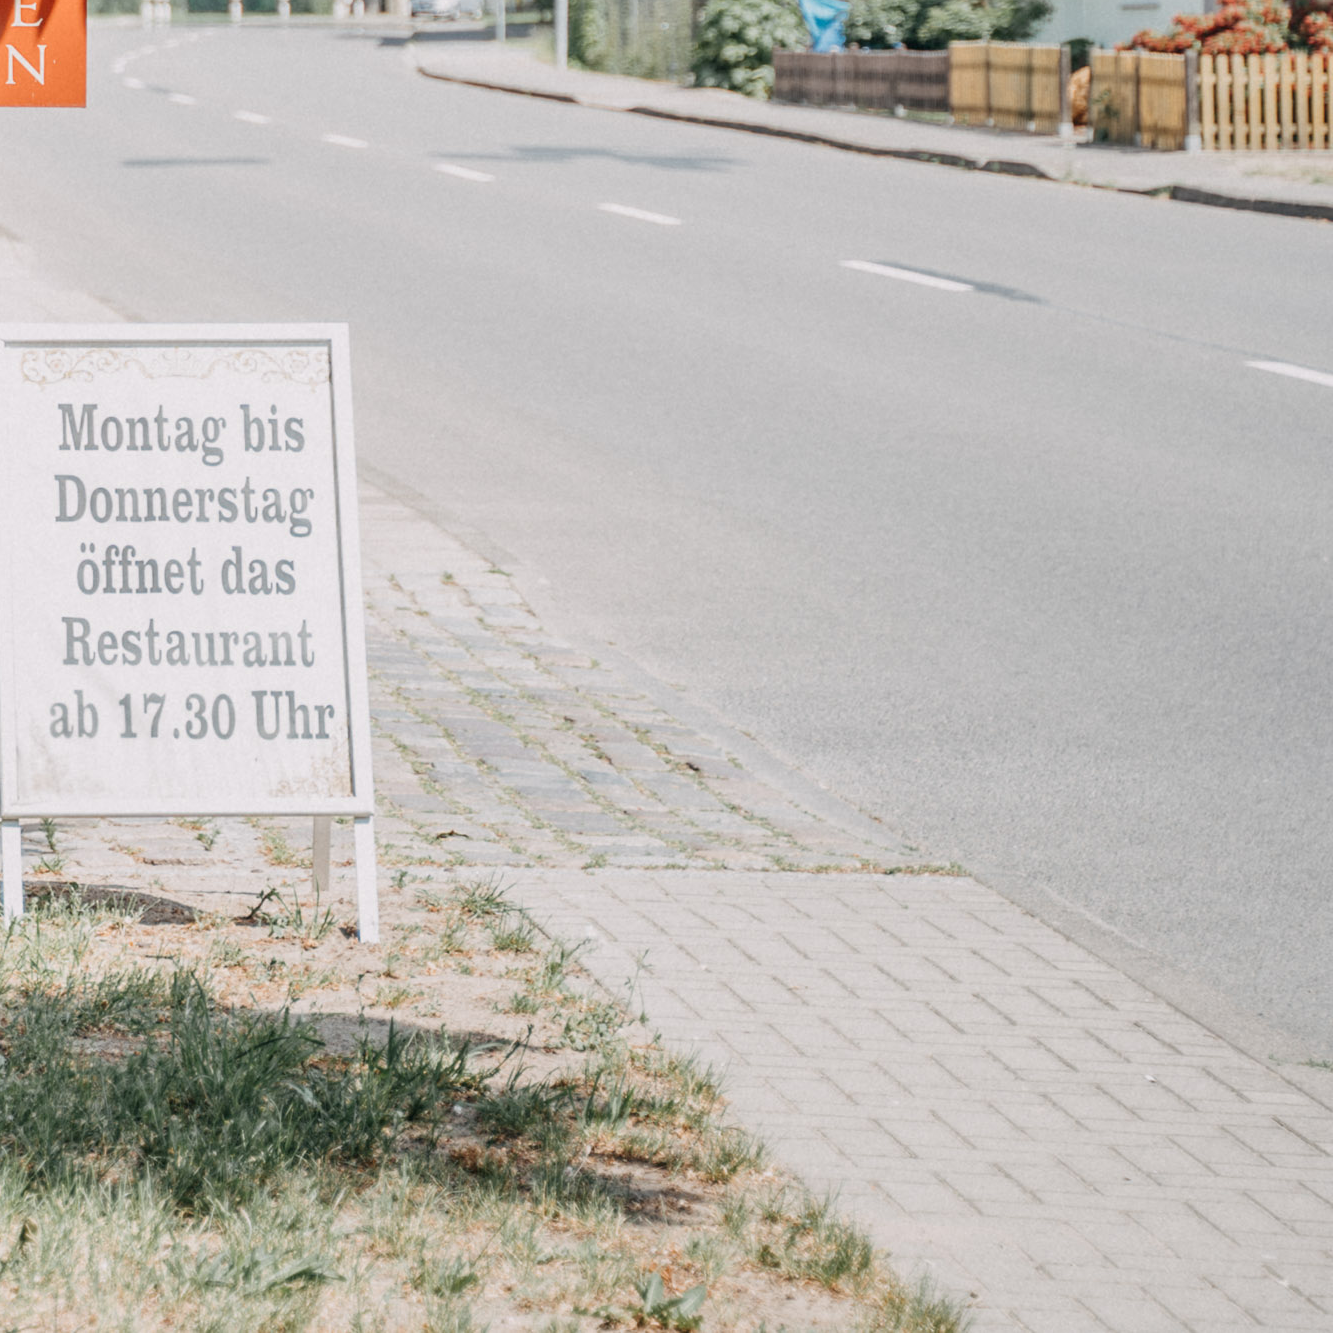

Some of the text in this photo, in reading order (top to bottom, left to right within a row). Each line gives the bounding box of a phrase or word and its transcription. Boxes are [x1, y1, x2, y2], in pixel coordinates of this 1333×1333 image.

[57, 402, 306, 468] Montag bis
[53, 473, 316, 539] Donnerstag
[76, 542, 297, 597] öffnet das
[61, 615, 316, 669] Restaurant
[48, 688, 336, 741] ab 17.30 Uhr
